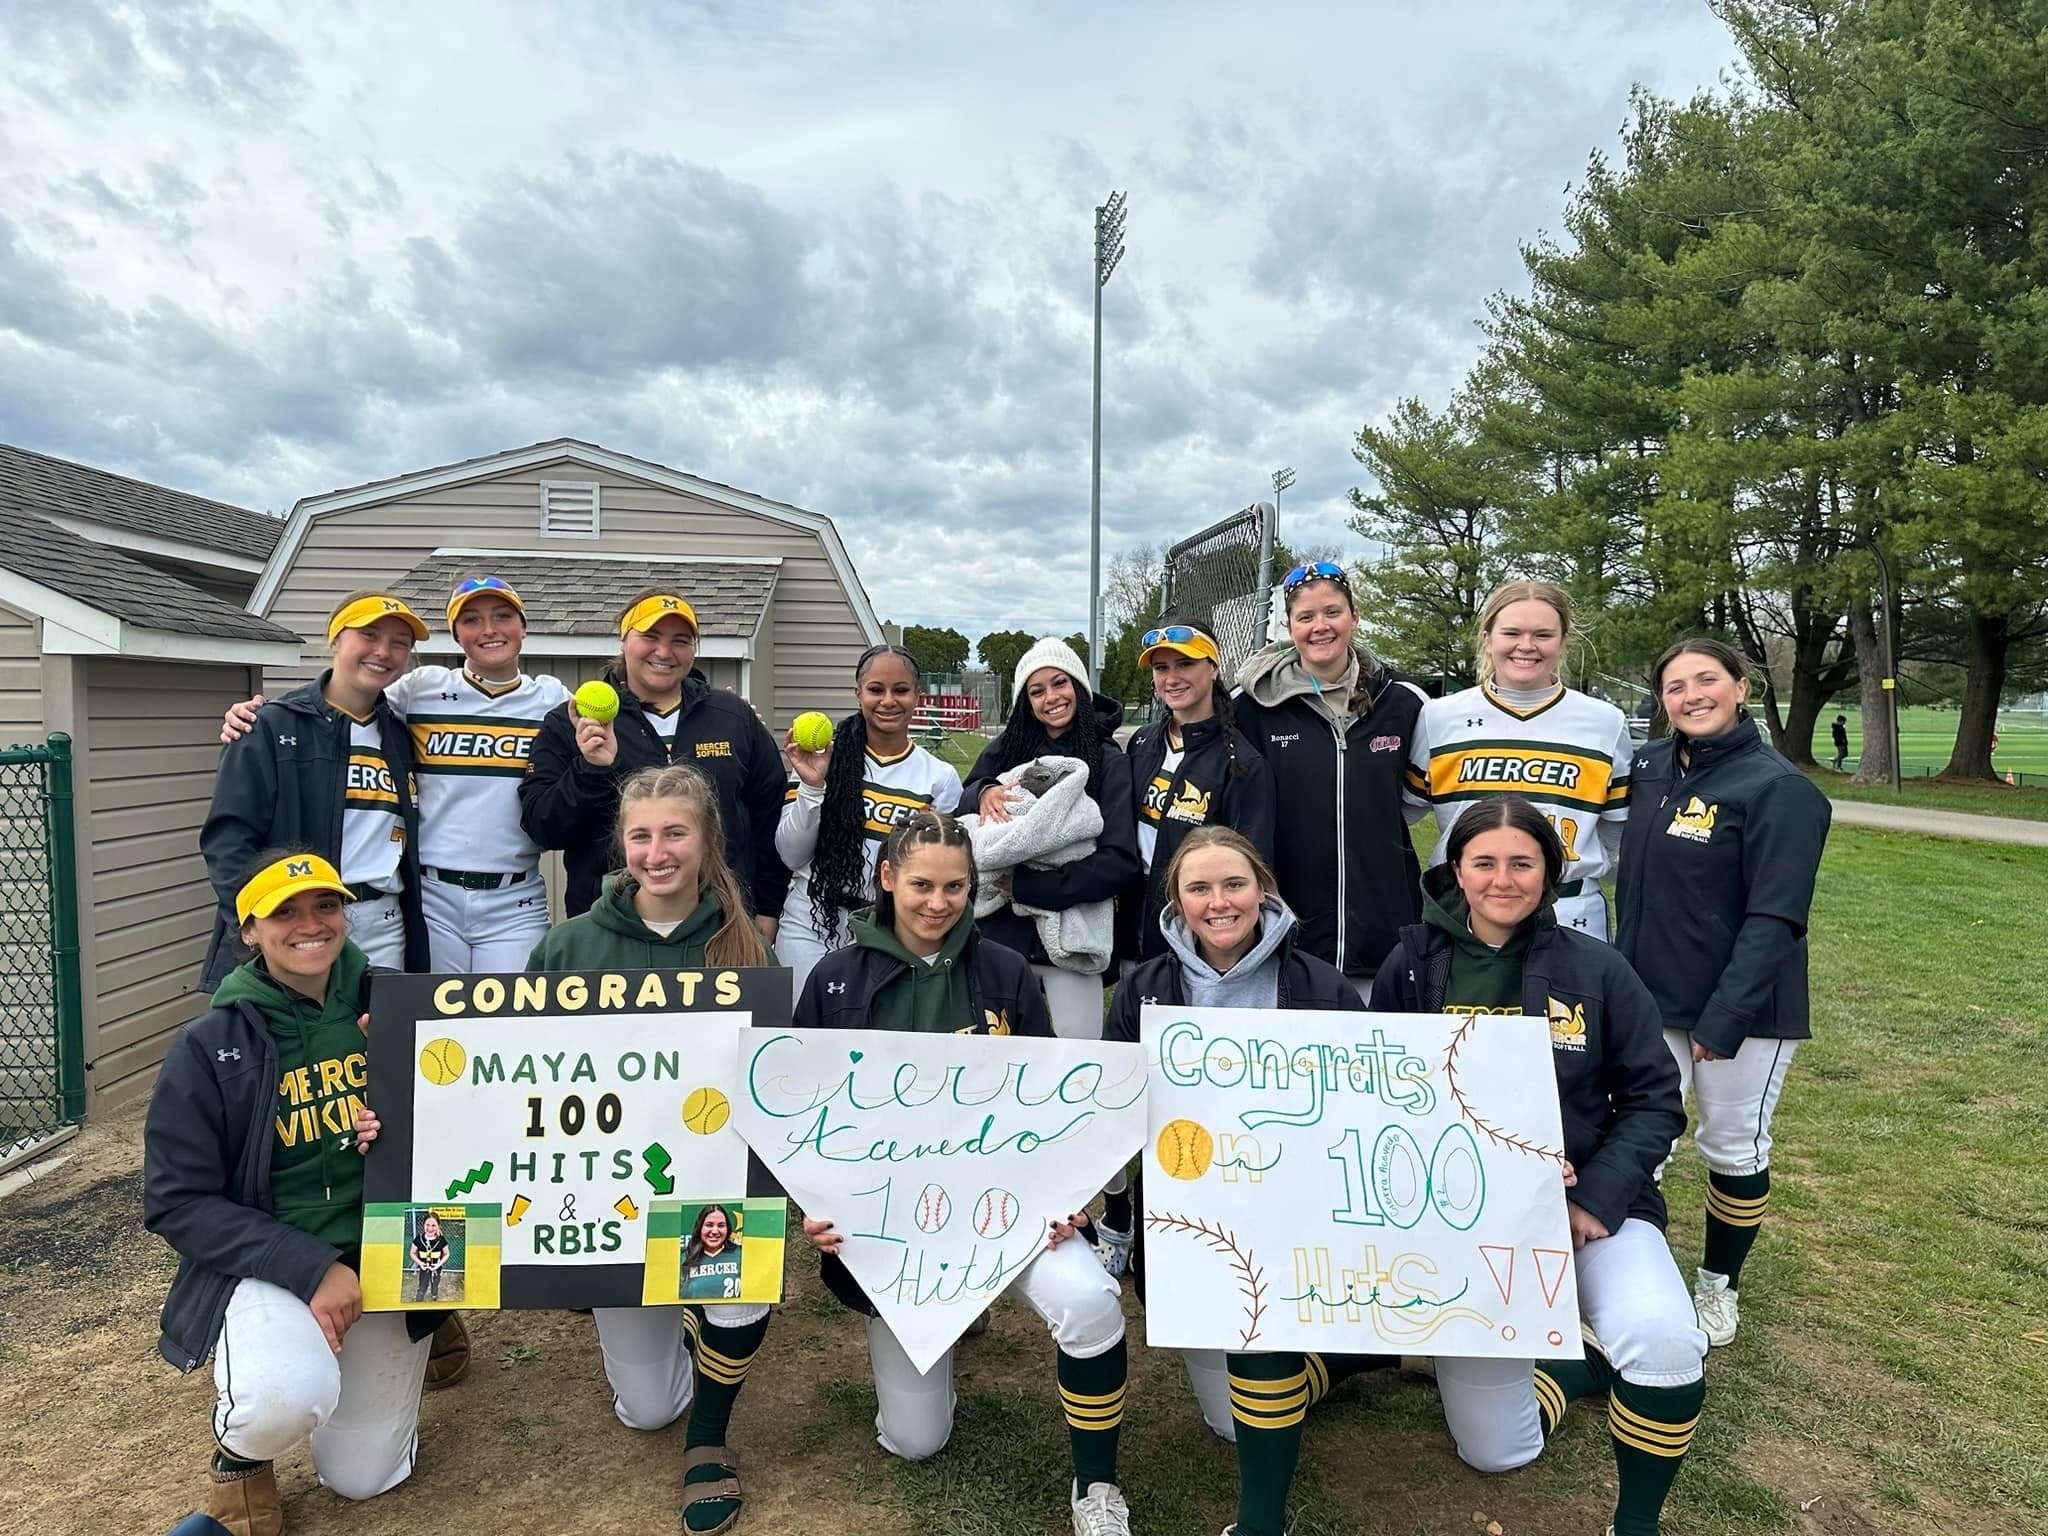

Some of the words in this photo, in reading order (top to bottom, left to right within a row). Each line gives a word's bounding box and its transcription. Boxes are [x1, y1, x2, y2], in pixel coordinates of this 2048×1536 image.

[383, 600, 400, 612] M
[662, 599, 679, 610] M
[695, 742, 731, 751] MERCER
[695, 750, 733, 758] SOFTBALL
[1271, 733, 1300, 742] Bonacci
[347, 764, 398, 793] ERC
[1458, 757, 1580, 788] MERCER
[1142, 785, 1168, 812] RC
[286, 860, 313, 877] M
[433, 971, 743, 1015] CONGRATS
[473, 1051, 598, 1085] MAYA
[617, 1050, 680, 1082] ON
[748, 1034, 1149, 1118] Cierra
[1160, 1021, 1436, 1129] Congrats
[525, 1092, 623, 1138] 100
[777, 1105, 1096, 1164] Acevedo
[510, 1150, 633, 1184] HITS
[1327, 1123, 1486, 1231] 100
[559, 1193, 577, 1221] &
[851, 1176, 1020, 1243] 100
[534, 1217, 622, 1254] RBI'S
[689, 1262, 738, 1278] MERCER
[872, 1216, 1047, 1306] Hits
[1293, 1245, 1494, 1346] Hits
